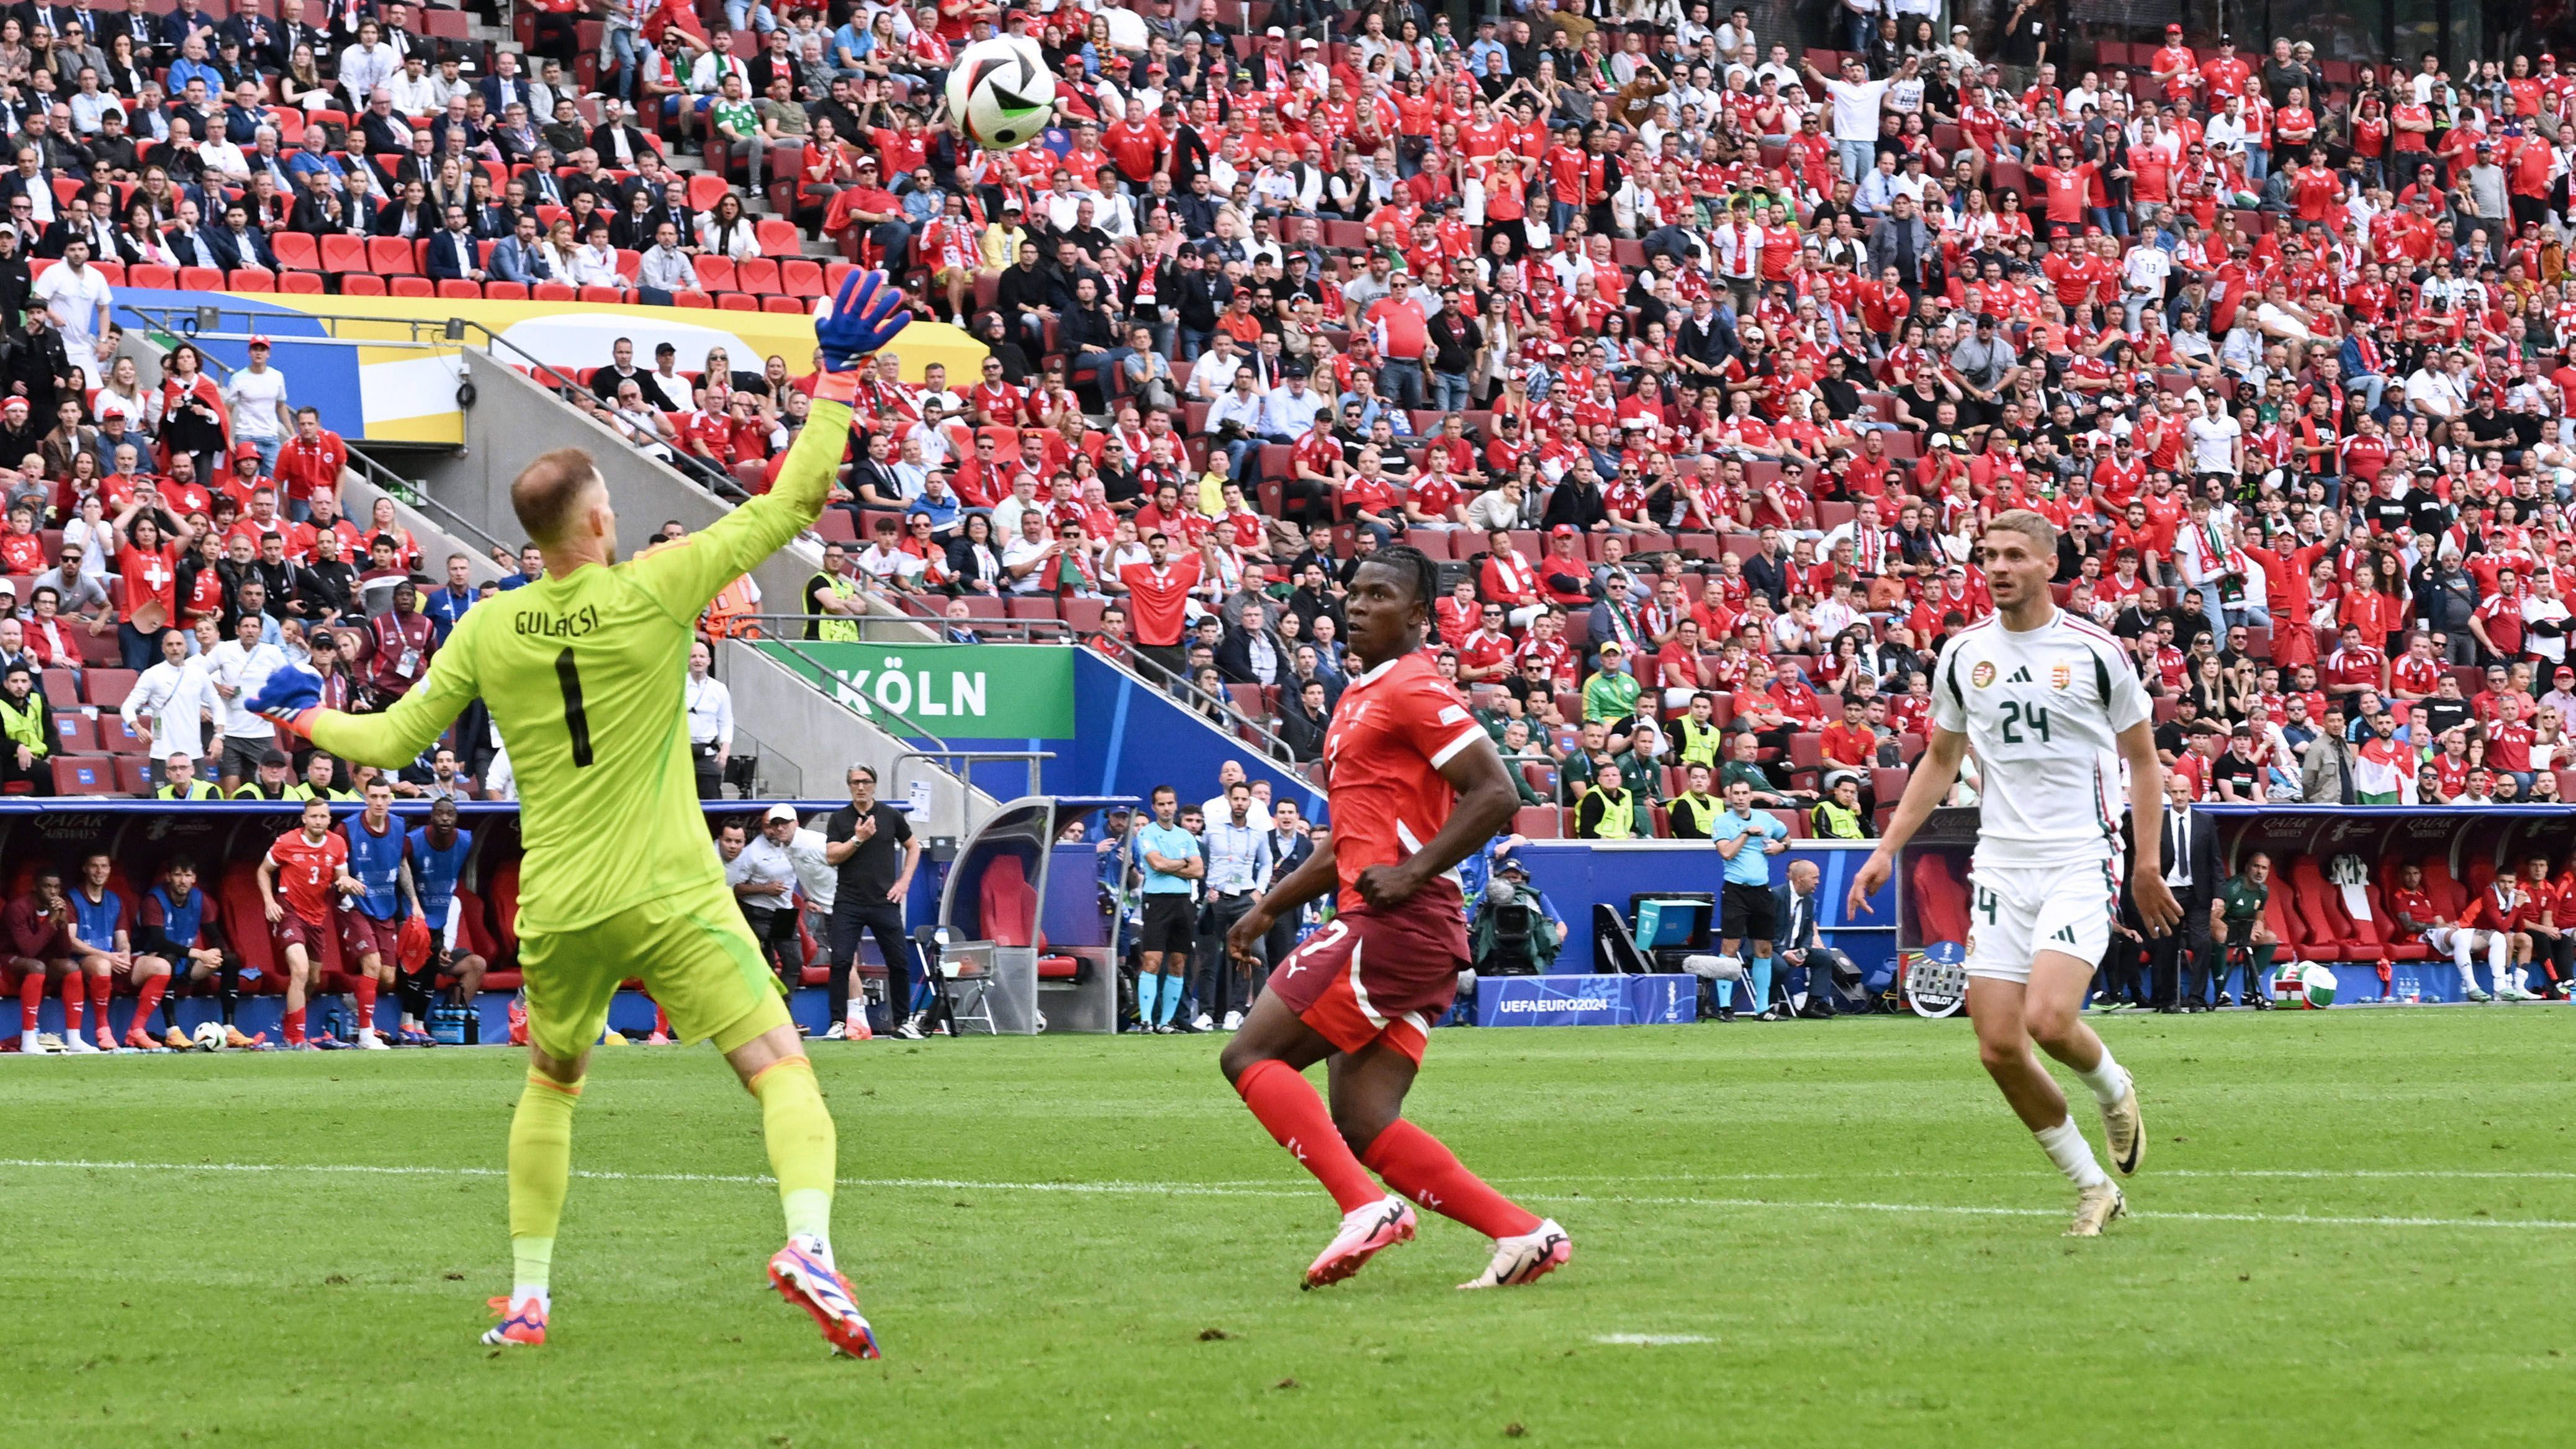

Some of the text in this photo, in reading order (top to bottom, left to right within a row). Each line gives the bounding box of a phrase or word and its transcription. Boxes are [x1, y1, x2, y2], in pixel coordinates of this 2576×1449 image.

[2146, 263, 2156, 274] 13
[193, 586, 204, 602] 5
[515, 604, 598, 637] GULÁCSI
[836, 656, 986, 716] KÖLN
[554, 646, 593, 768] 1
[1999, 701, 2049, 743] 24
[308, 866, 320, 885] 3
[1301, 919, 1348, 957] 7
[1917, 993, 1954, 1005] HUBLOT
